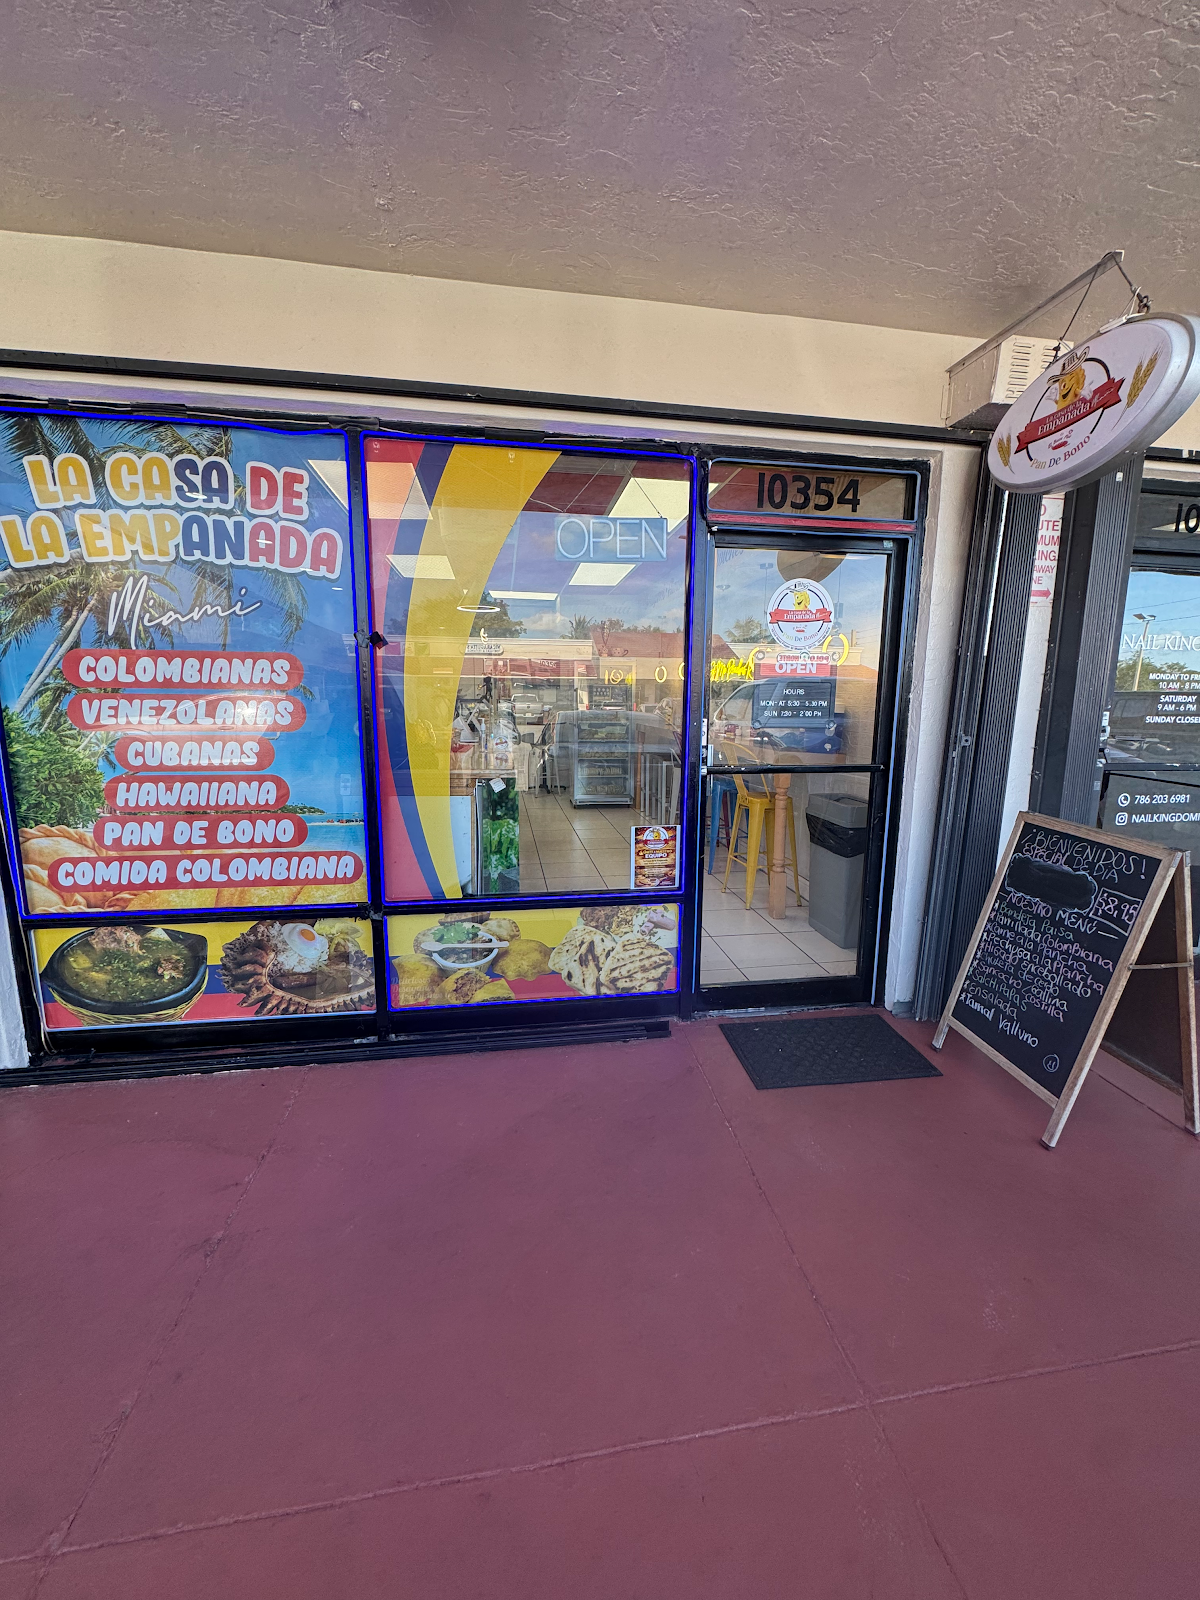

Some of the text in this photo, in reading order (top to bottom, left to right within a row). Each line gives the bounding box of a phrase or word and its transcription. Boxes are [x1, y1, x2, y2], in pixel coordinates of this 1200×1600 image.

[1037, 401, 1091, 435] Empanada
[1030, 457, 1047, 470] Pan
[1048, 456, 1062, 468] De
[1063, 435, 1091, 462] Bono
[22, 452, 310, 520] LA CASA DE
[757, 472, 860, 513] 10354
[1174, 503, 1200, 534] 10
[0, 509, 343, 579] LA EMPANADA
[556, 518, 667, 559] OPEN
[1036, 550, 1056, 561] ING
[107, 574, 262, 650] Miami
[784, 613, 816, 621] Empanada
[803, 632, 819, 641] Bono
[1122, 634, 1160, 650] NAIL
[78, 656, 291, 685] COLOMBIANAS
[775, 661, 817, 674] OPEN
[81, 699, 294, 726] VENEZOLANAS
[1160, 695, 1197, 703] SATURDAY
[127, 741, 260, 766] CUBANAS
[116, 781, 277, 807] HAWAIIANA
[1134, 794, 1191, 804] 786 203 6981
[104, 818, 295, 846] PAN DE BONO
[57, 855, 355, 886] COMIDA COLOMBIANA
[1023, 843, 1069, 868] ESPECIAL
[1073, 856, 1091, 873] DE
[1041, 919, 1074, 941] Paisa
[965, 992, 995, 1022] Tamal
